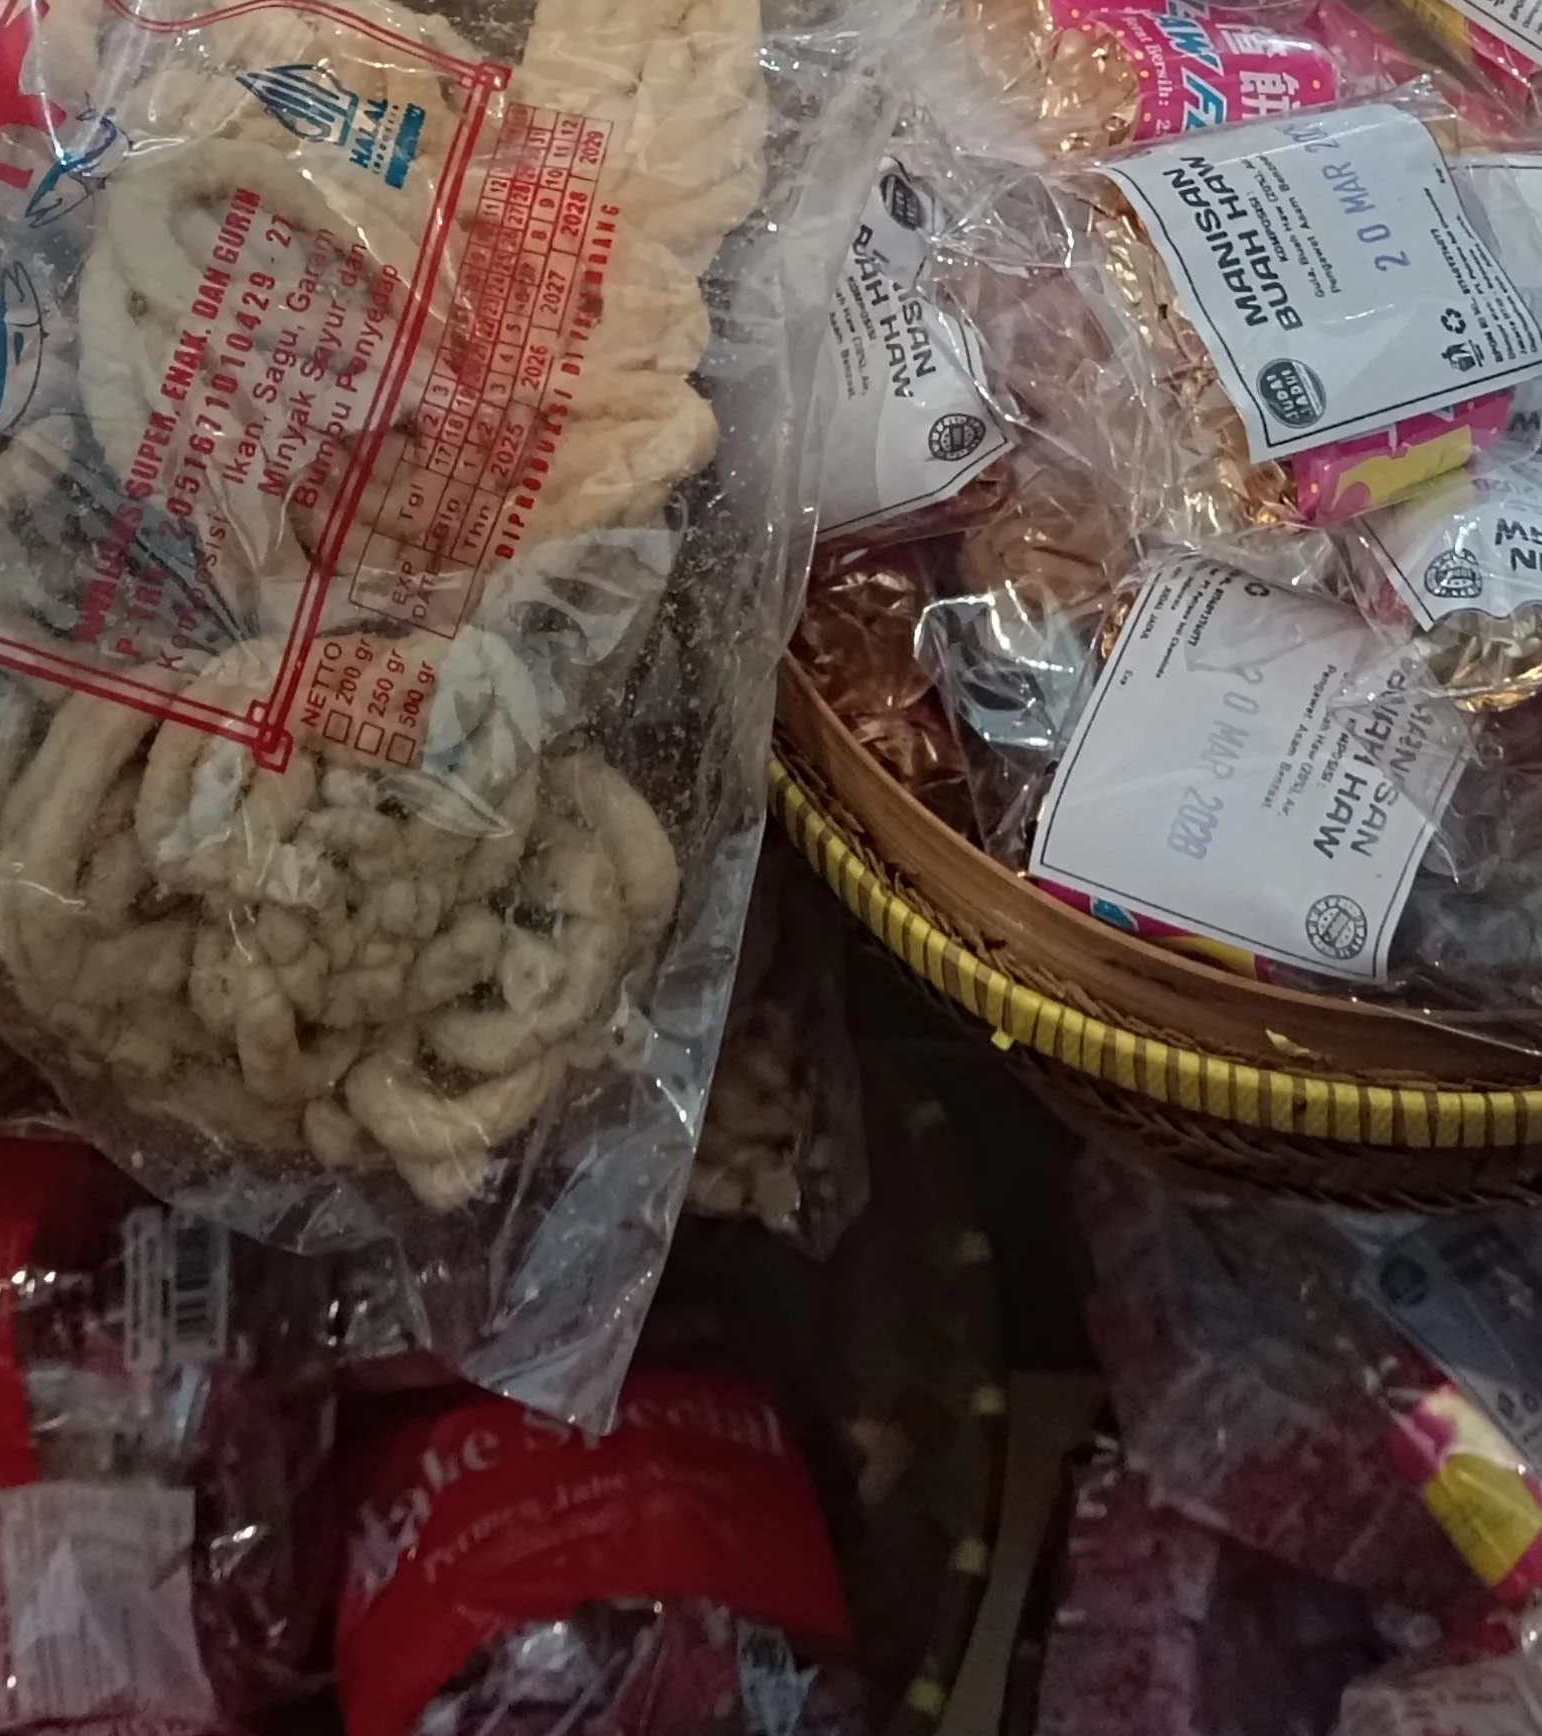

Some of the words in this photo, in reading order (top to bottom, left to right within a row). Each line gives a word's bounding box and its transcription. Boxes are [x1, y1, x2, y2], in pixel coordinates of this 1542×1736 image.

[349, 96, 390, 170] HALAL
[553, 141, 572, 159] 11
[560, 118, 578, 137] 12
[488, 177, 507, 195] 12
[511, 181, 532, 202] 28
[544, 167, 563, 188] 10
[1178, 155, 1248, 222] HAW
[1320, 157, 1377, 217] MAR
[482, 200, 500, 218] 11
[507, 206, 526, 226] 27
[537, 195, 555, 209] 9
[1285, 194, 1311, 230] Asam
[530, 228, 548, 242] 8
[1162, 163, 1268, 328] MANISAN
[1248, 194, 1289, 263] KOMPOSISI
[1236, 226, 1303, 331] BUAH
[1305, 233, 1342, 293] Pengawet
[461, 501, 493, 551] Thn
[489, 419, 526, 479] 2025
[519, 342, 550, 391] 2026
[539, 269, 568, 315] 2027
[559, 188, 589, 237] 2028
[579, 128, 604, 165] 2029
[506, 321, 521, 333] 5
[255, 387, 321, 499] Minyak
[298, 297, 355, 385] Sayur
[334, 239, 370, 288] dan
[497, 351, 514, 364] 4
[877, 313, 921, 399] HAW
[122, 401, 182, 502] SUPER,
[158, 320, 212, 403] ENAK,
[189, 265, 232, 321] DAN
[222, 408, 272, 487] Ikan,
[251, 317, 308, 406] Sagu,
[291, 397, 352, 509] Bumbu
[333, 260, 407, 396] Penyedap
[432, 383, 450, 397] 3
[454, 386, 475, 410] 19
[490, 381, 507, 394] 3
[424, 412, 441, 427] 2
[444, 416, 465, 440] 18
[434, 445, 455, 467] 17
[390, 559, 417, 605] EXP
[299, 639, 343, 728] NETTO
[334, 664, 362, 706] 200
[352, 636, 377, 663] gr
[366, 675, 394, 718] 250
[385, 647, 409, 674] gr
[397, 687, 424, 729] 500
[416, 659, 439, 686] gr
[1299, 661, 1337, 721] Pengawet
[1190, 716, 1251, 784] MAR
[1283, 721, 1309, 759] Asam
[1303, 731, 1327, 763] Haw
[1159, 783, 1230, 864] 2028
[1275, 795, 1297, 820] Air,
[1307, 769, 1369, 861] HAW
